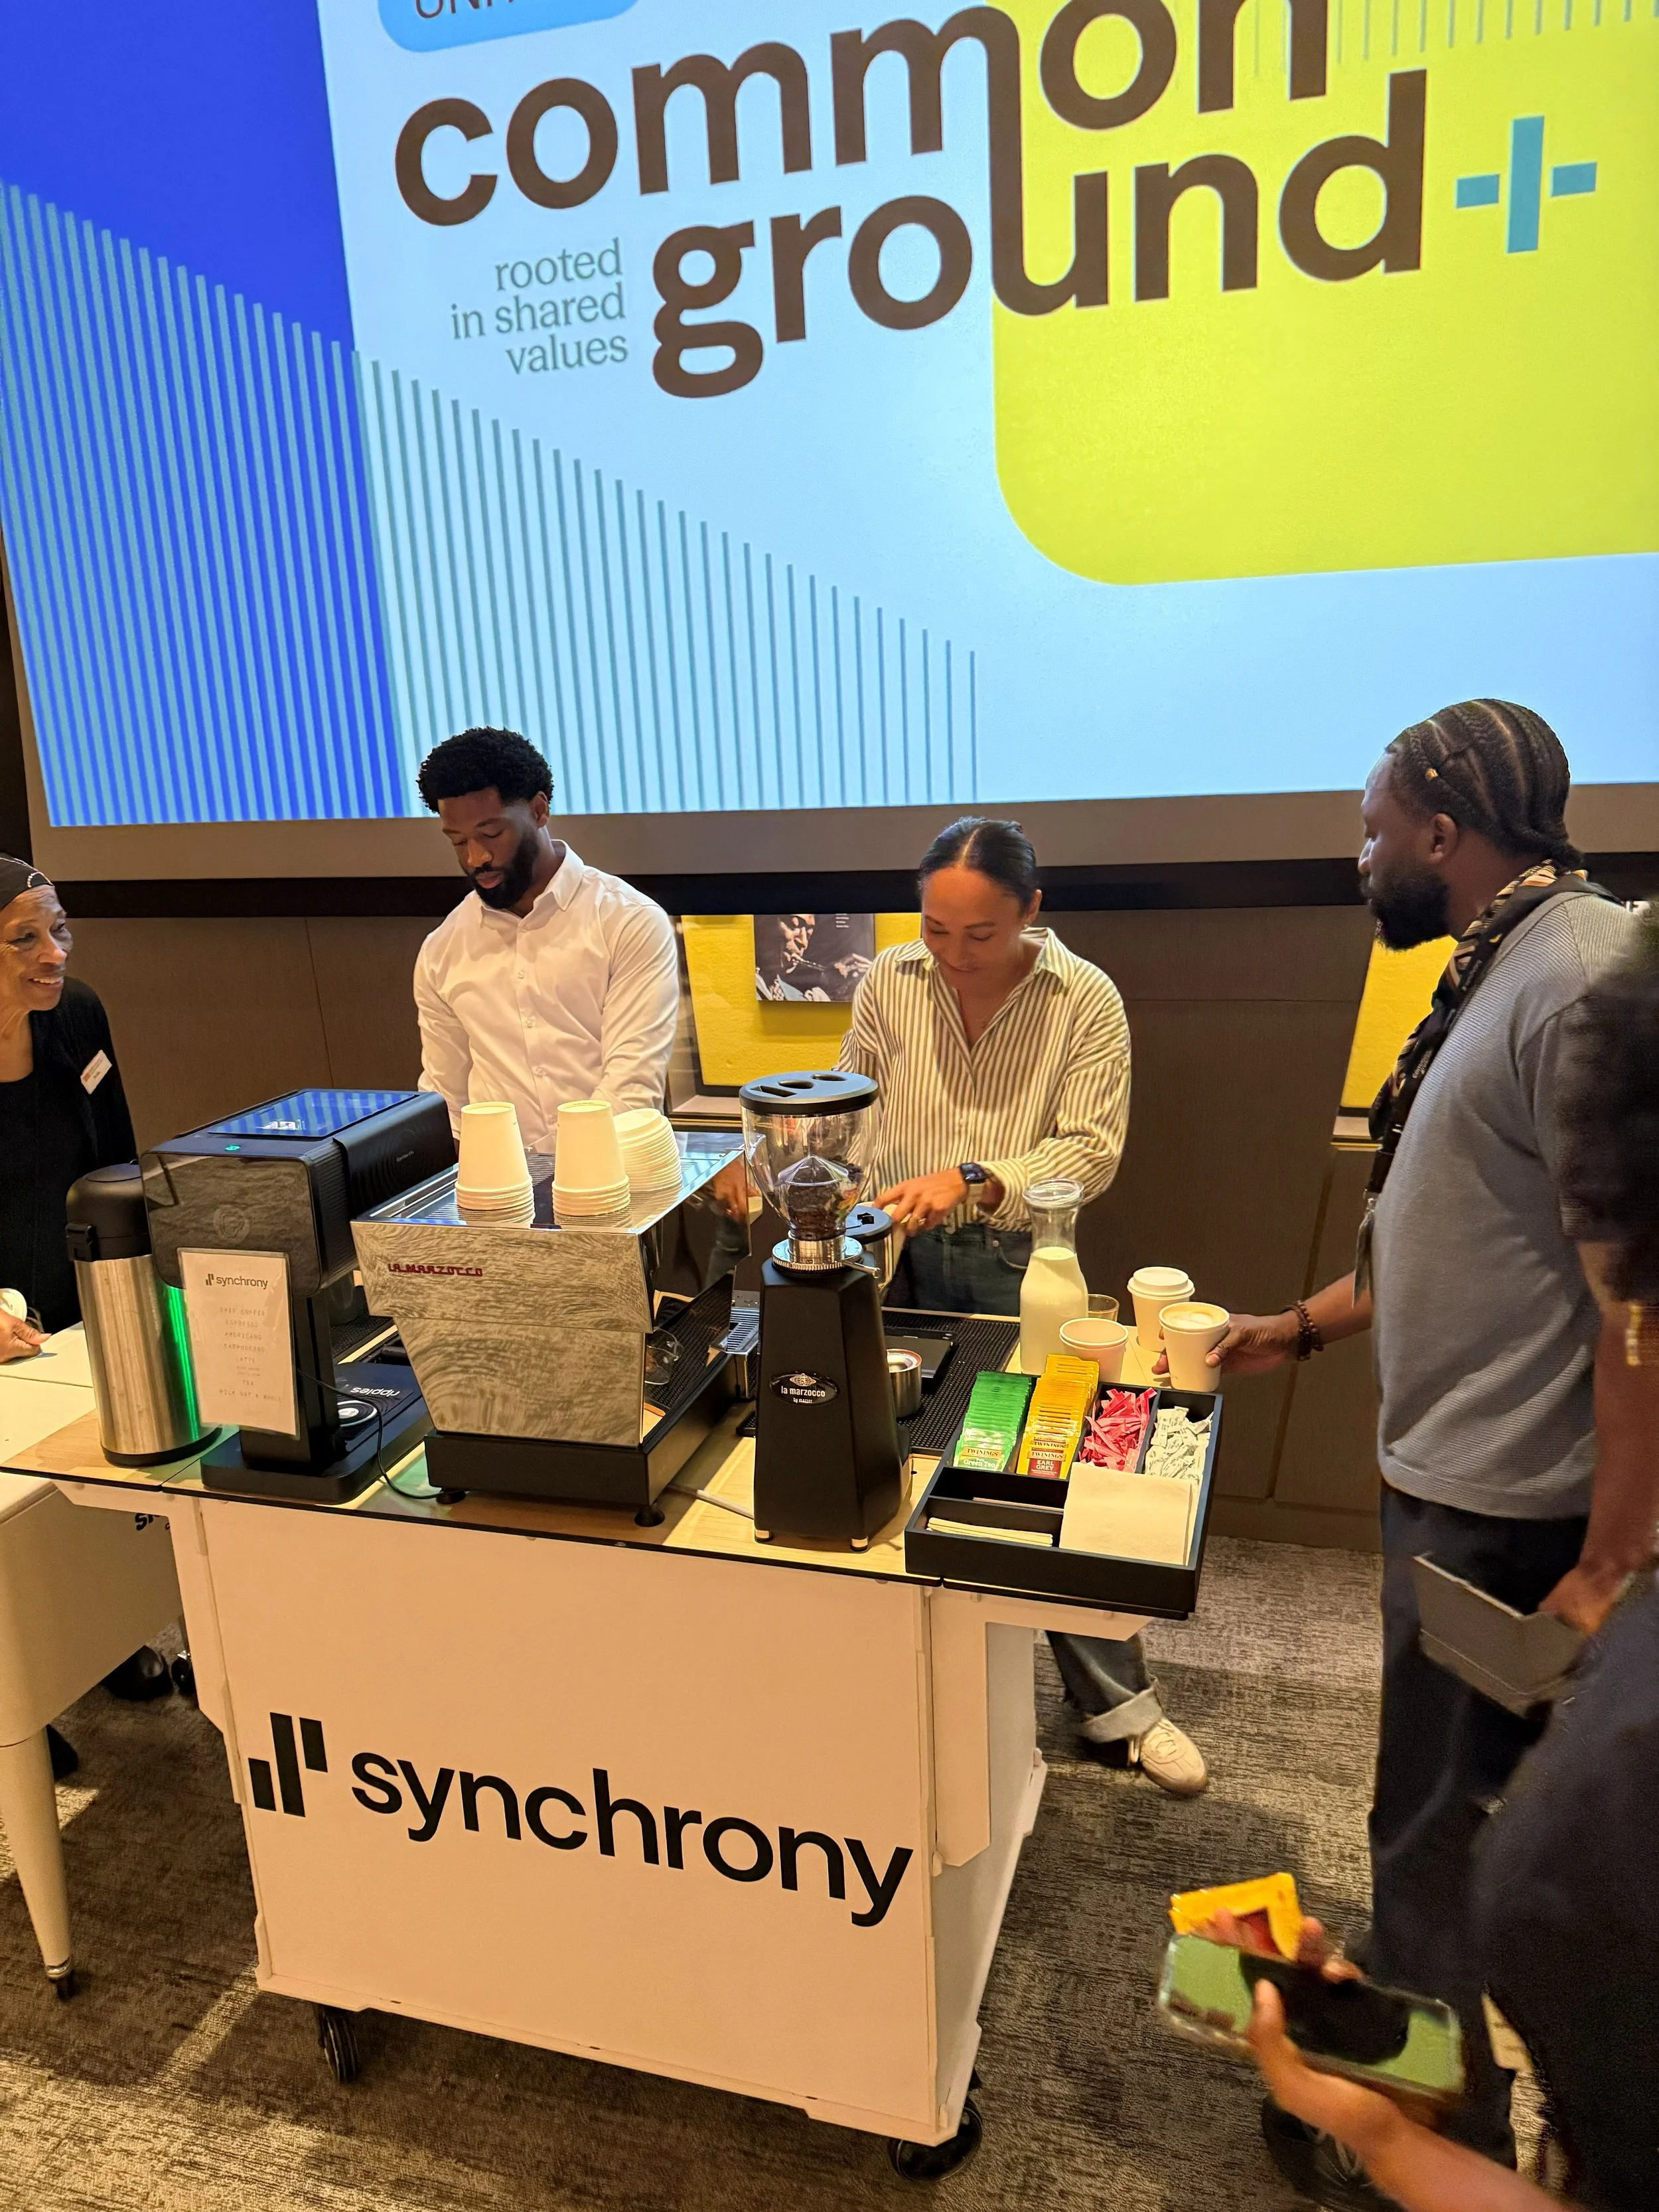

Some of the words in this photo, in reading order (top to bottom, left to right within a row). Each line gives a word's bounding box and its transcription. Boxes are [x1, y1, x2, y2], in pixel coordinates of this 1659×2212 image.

[396, 0, 1327, 226] common
[654, 68, 1427, 398] ground
[495, 236, 622, 291] rooted
[451, 303, 486, 340] in
[495, 281, 626, 334] shared
[505, 333, 628, 374] values
[216, 1275, 268, 1290] synchrony
[350, 1387, 400, 1397] ripples
[781, 1385, 788, 1394] la
[790, 1388, 826, 1397] marzocco
[967, 1448, 999, 1457] TWININGS
[352, 1752, 914, 1927] synchrony
